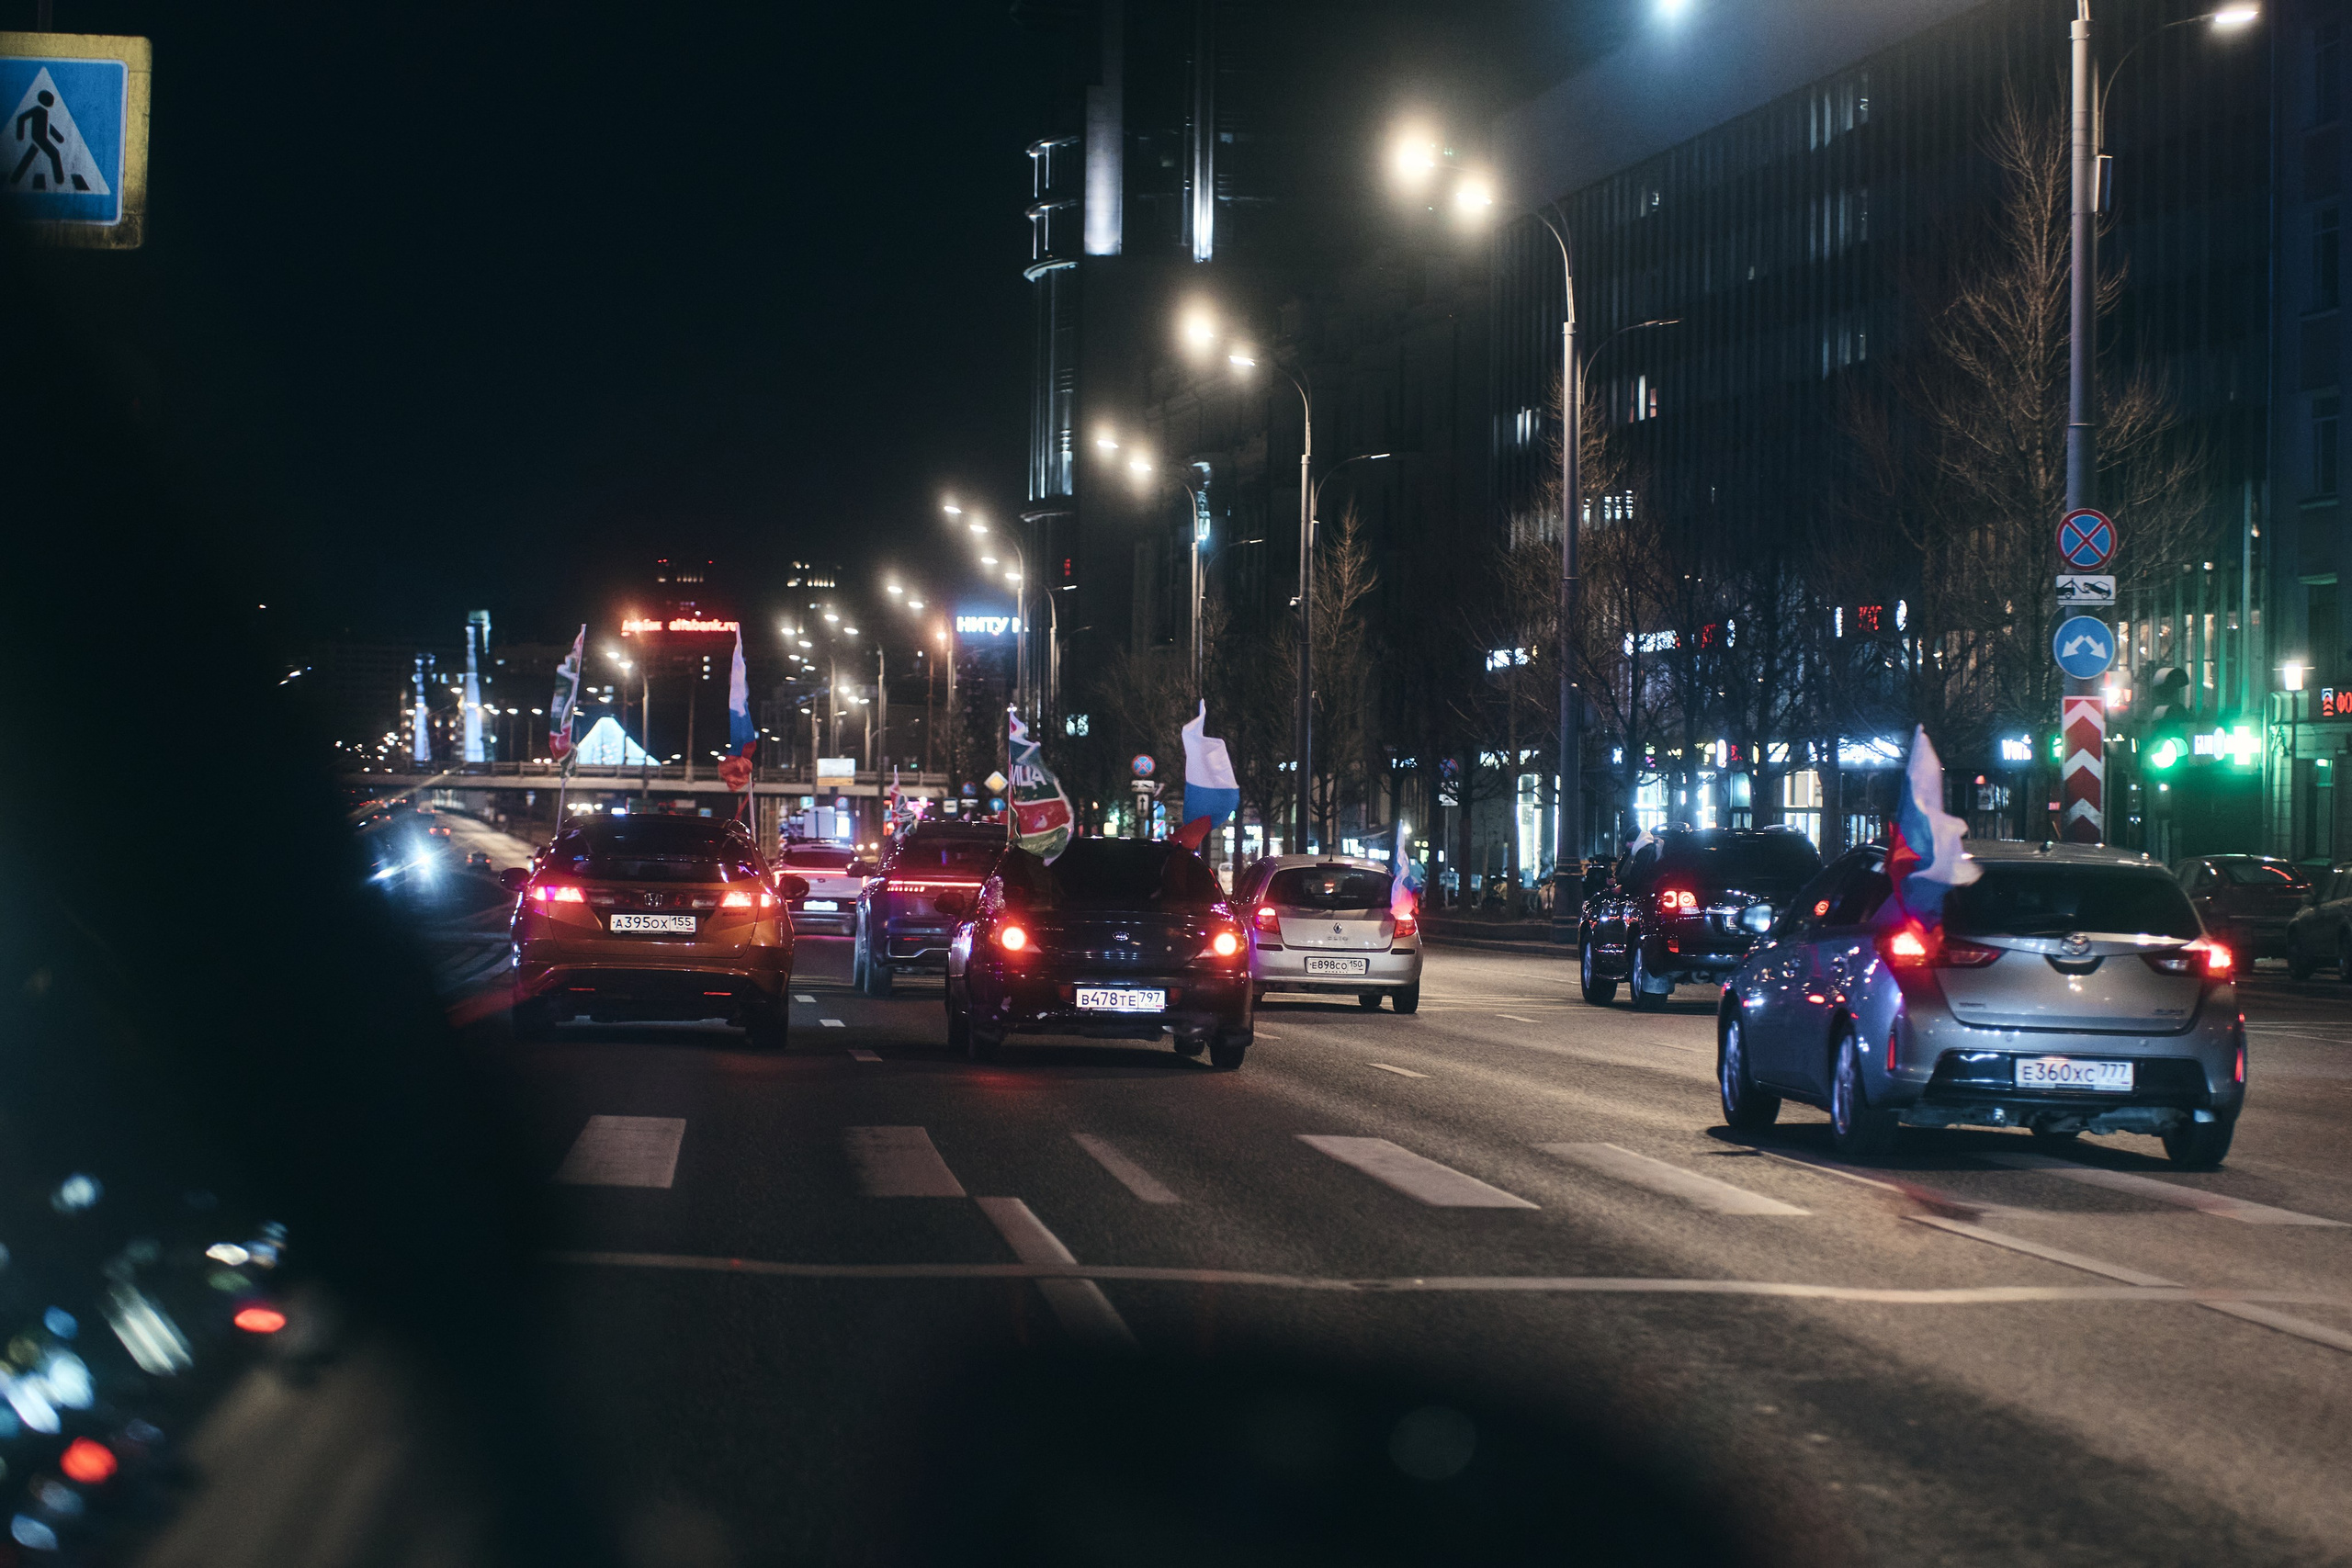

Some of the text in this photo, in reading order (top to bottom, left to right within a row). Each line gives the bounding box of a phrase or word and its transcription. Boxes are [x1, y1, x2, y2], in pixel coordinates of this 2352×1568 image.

[956, 616, 1010, 633] НИТУ
[671, 917, 692, 927] 155
[1139, 991, 1160, 1003] 797
[2099, 1063, 2127, 1078] 777
